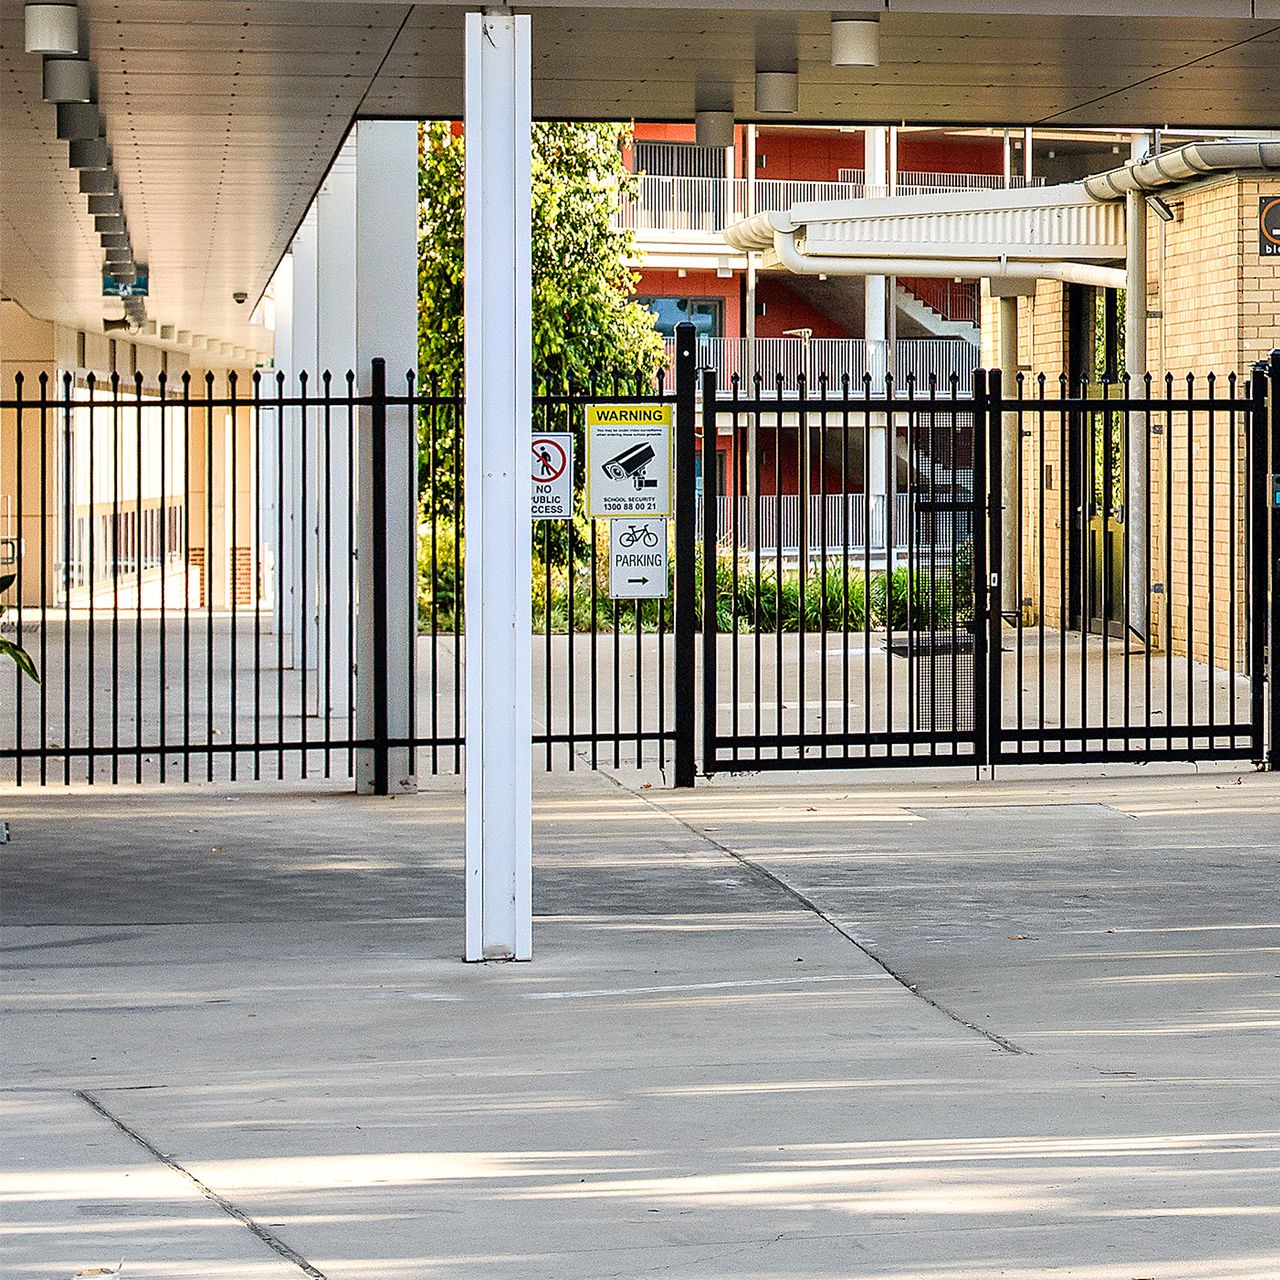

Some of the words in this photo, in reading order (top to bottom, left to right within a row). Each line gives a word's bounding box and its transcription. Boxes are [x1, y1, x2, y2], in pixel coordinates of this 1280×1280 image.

[596, 410, 663, 421] WARNING
[536, 485, 552, 494] NO
[531, 496, 561, 504] UBLIC
[531, 505, 563, 513] CCESS
[603, 503, 622, 511] 1300
[623, 503, 634, 511] 88
[635, 503, 646, 511] 00
[646, 503, 656, 511] 21
[615, 554, 662, 567] PARKING
